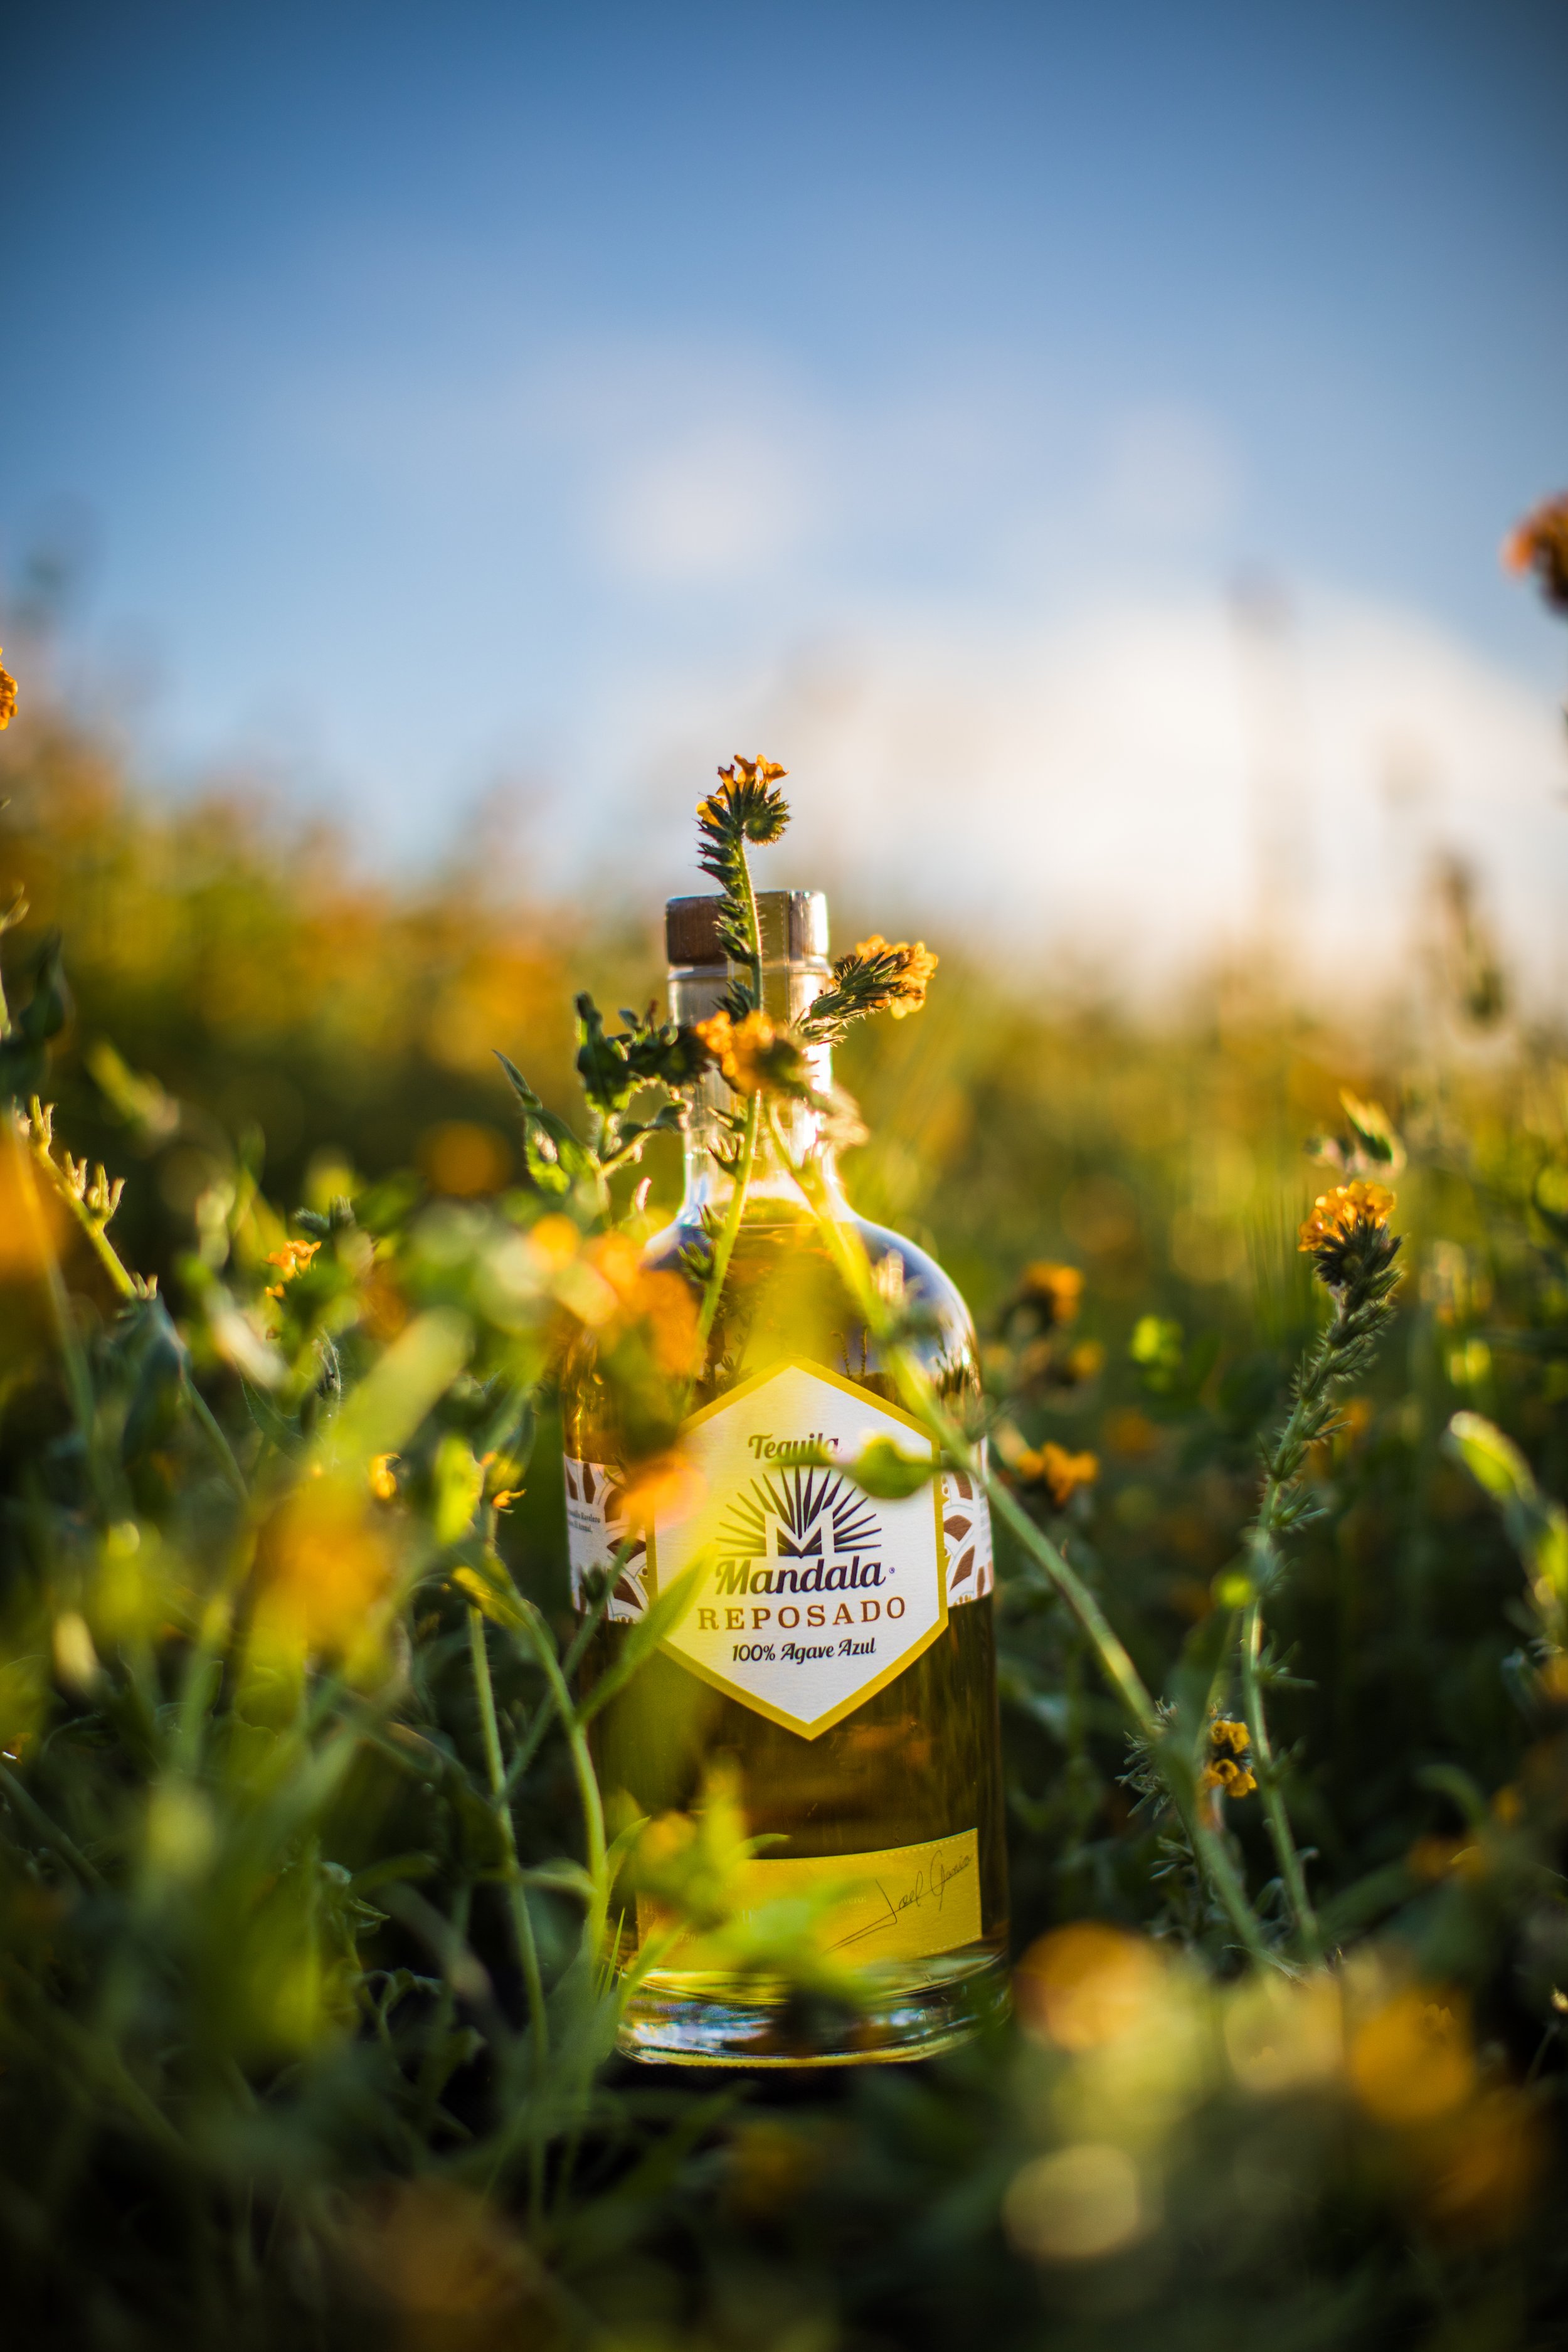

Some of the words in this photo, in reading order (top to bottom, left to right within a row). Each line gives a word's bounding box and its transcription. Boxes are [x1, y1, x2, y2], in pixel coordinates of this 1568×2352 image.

[748, 1433, 842, 1459] Tequila
[716, 1555, 886, 1595] Mandala
[697, 1596, 905, 1629] REPOSADO
[733, 1643, 776, 1661] 100%
[781, 1643, 835, 1665] Agave
[838, 1638, 877, 1656] Azul
